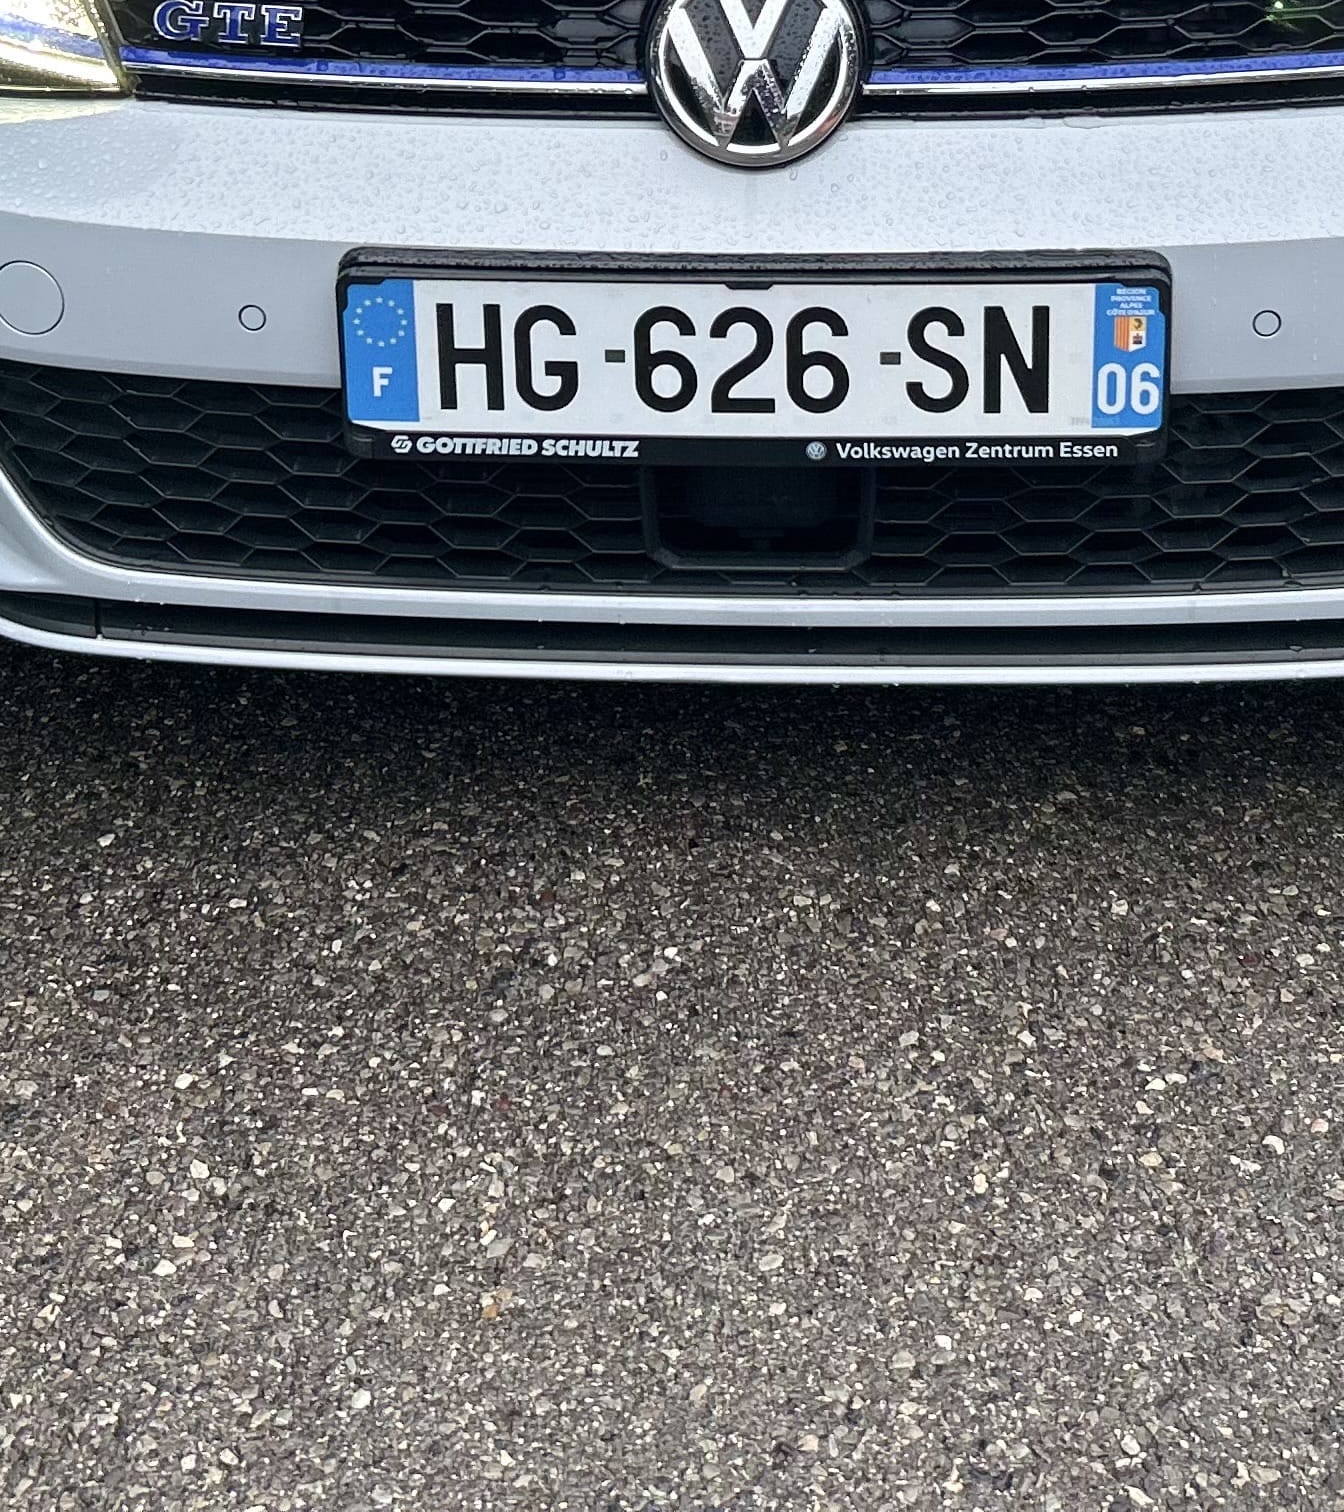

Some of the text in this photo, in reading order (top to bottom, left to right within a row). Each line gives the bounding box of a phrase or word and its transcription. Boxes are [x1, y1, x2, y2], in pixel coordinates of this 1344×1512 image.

[372, 367, 393, 397] F
[1097, 362, 1160, 415] 06
[416, 438, 639, 458] GOTTFRIED SCHULTZ
[836, 442, 959, 462] Volkswagen
[965, 442, 1053, 458] Zentrum
[1059, 442, 1118, 457] Essen
